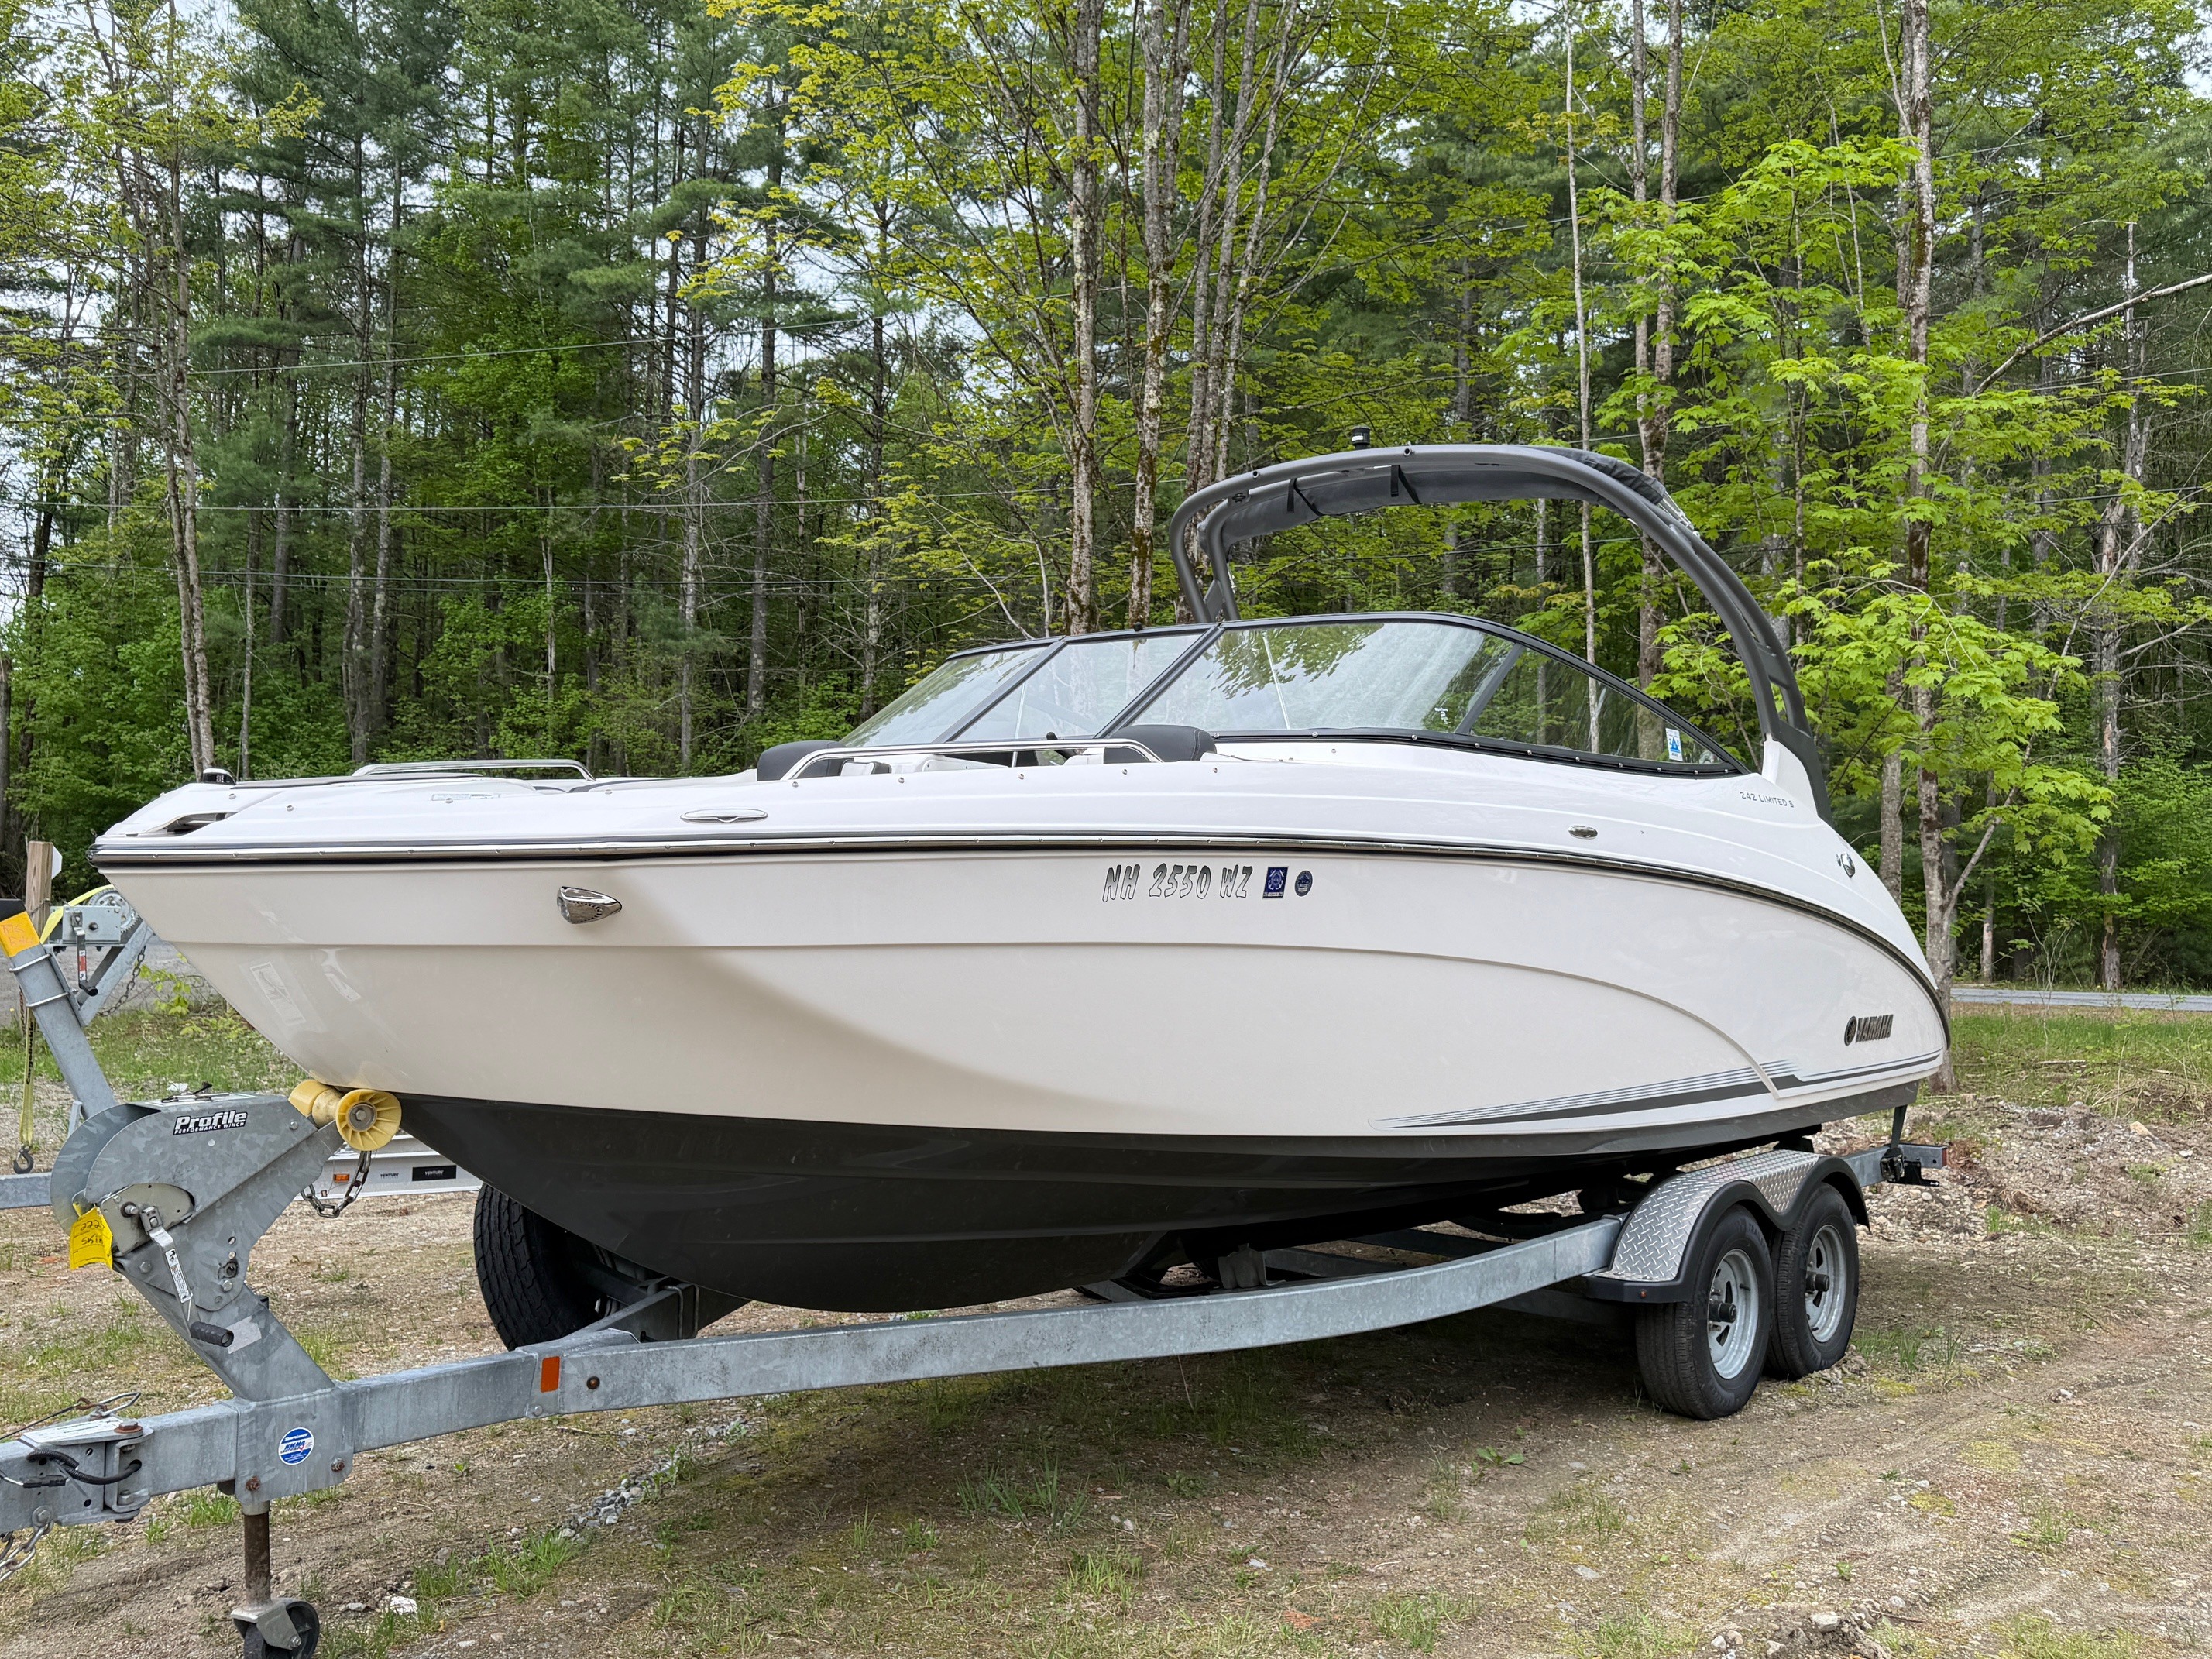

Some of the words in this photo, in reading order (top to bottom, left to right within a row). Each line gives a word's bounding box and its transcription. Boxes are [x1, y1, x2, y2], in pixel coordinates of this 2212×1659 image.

[1740, 791, 1757, 801] 242
[1758, 794, 1788, 806] LIMITED
[1102, 864, 1141, 902] NH
[1149, 863, 1211, 899] 2550
[1220, 864, 1253, 898] WZ
[1856, 1014, 1894, 1043] YAMAHA
[174, 1123, 222, 1135] PERFORMANCE
[175, 1111, 247, 1130] Profile
